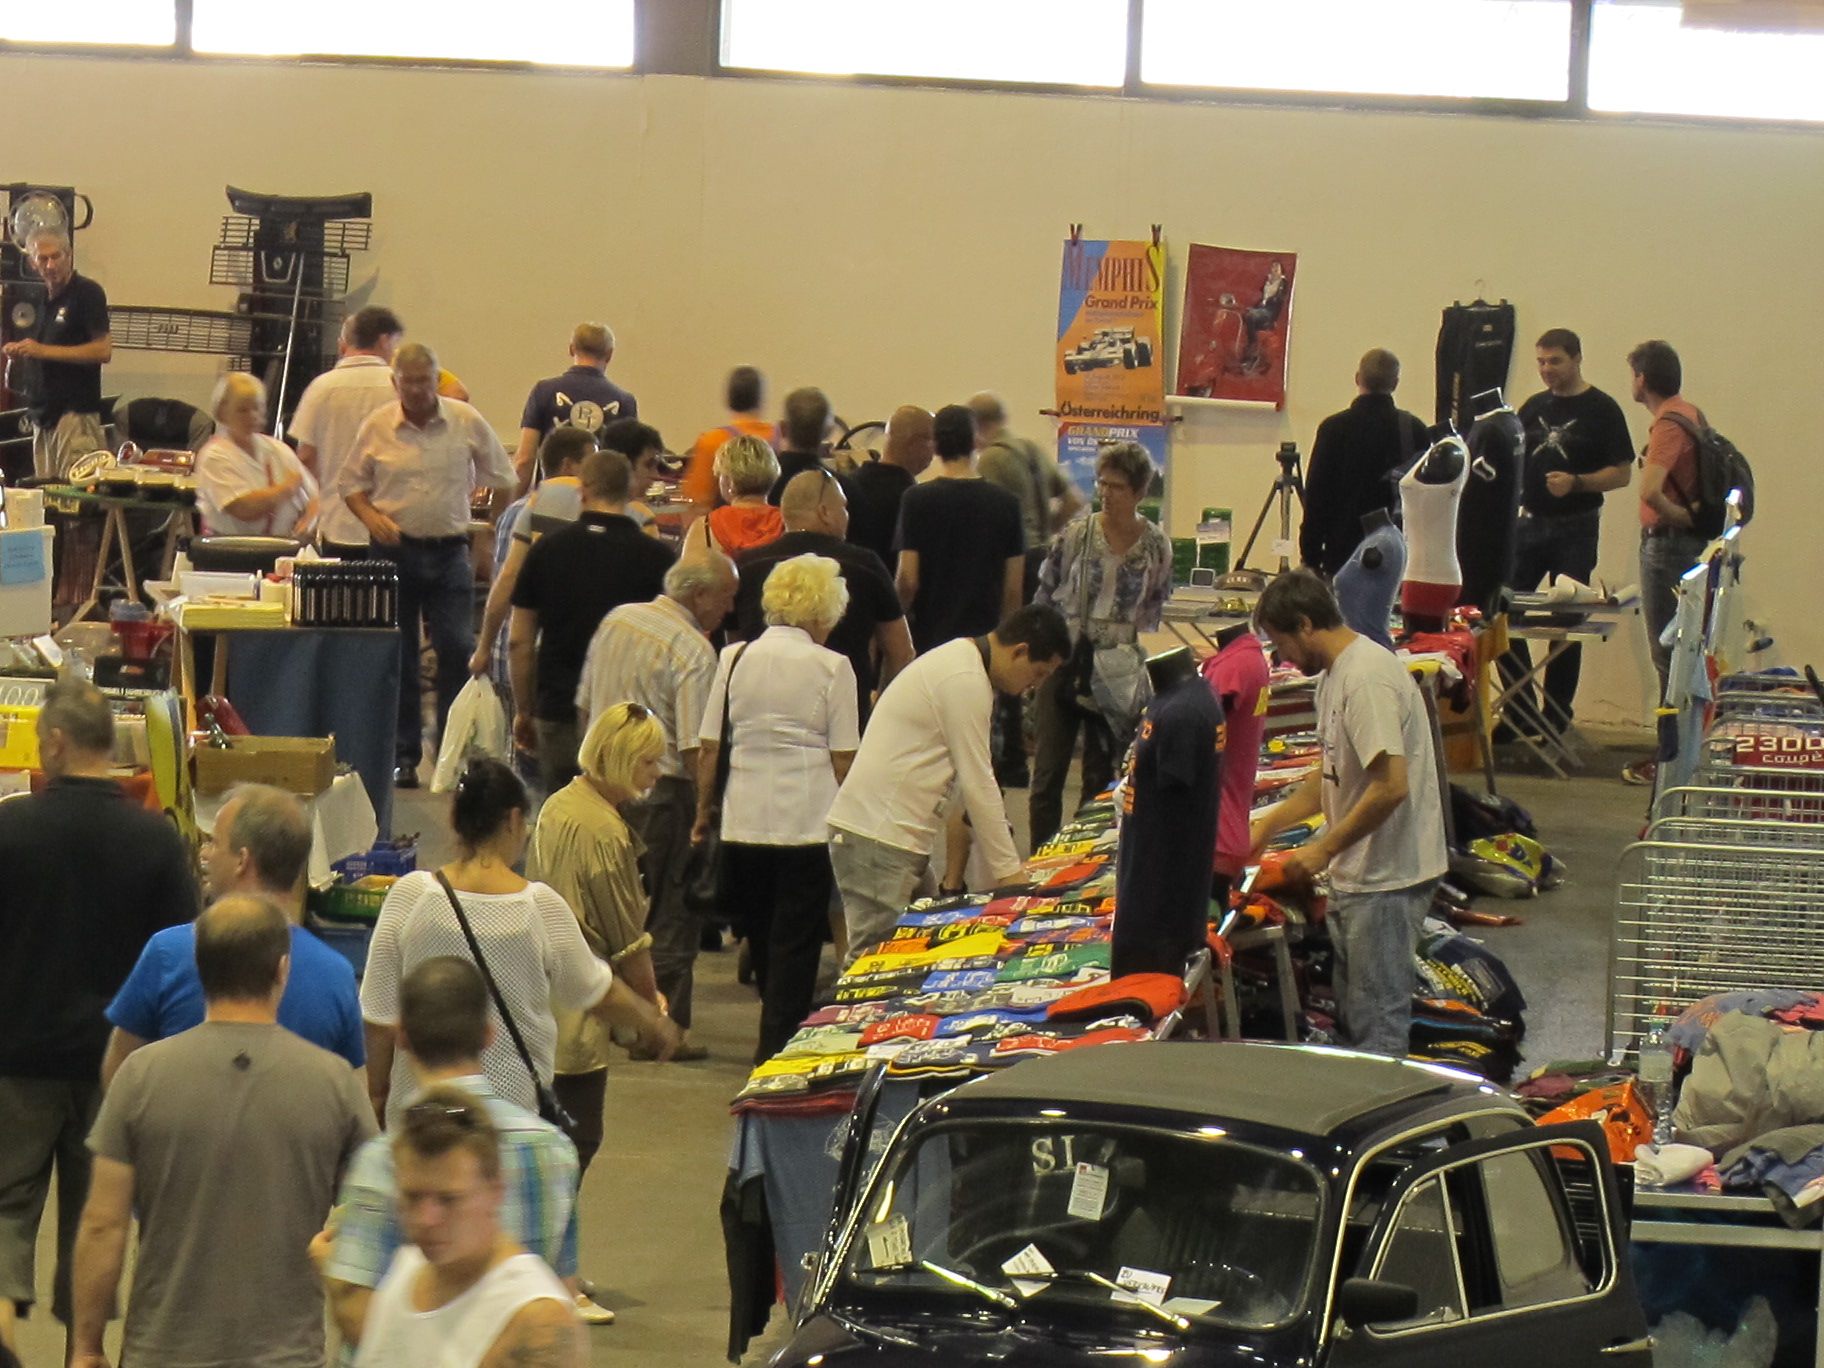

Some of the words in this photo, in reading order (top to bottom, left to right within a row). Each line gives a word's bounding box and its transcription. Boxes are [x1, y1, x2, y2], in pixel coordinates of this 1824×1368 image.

[1067, 243, 1160, 293] MEMPHIS
[1085, 295, 1129, 309] Grand
[1131, 296, 1158, 309] Prix
[1060, 401, 1161, 422] Österreichring
[1736, 736, 1824, 752] 2300
